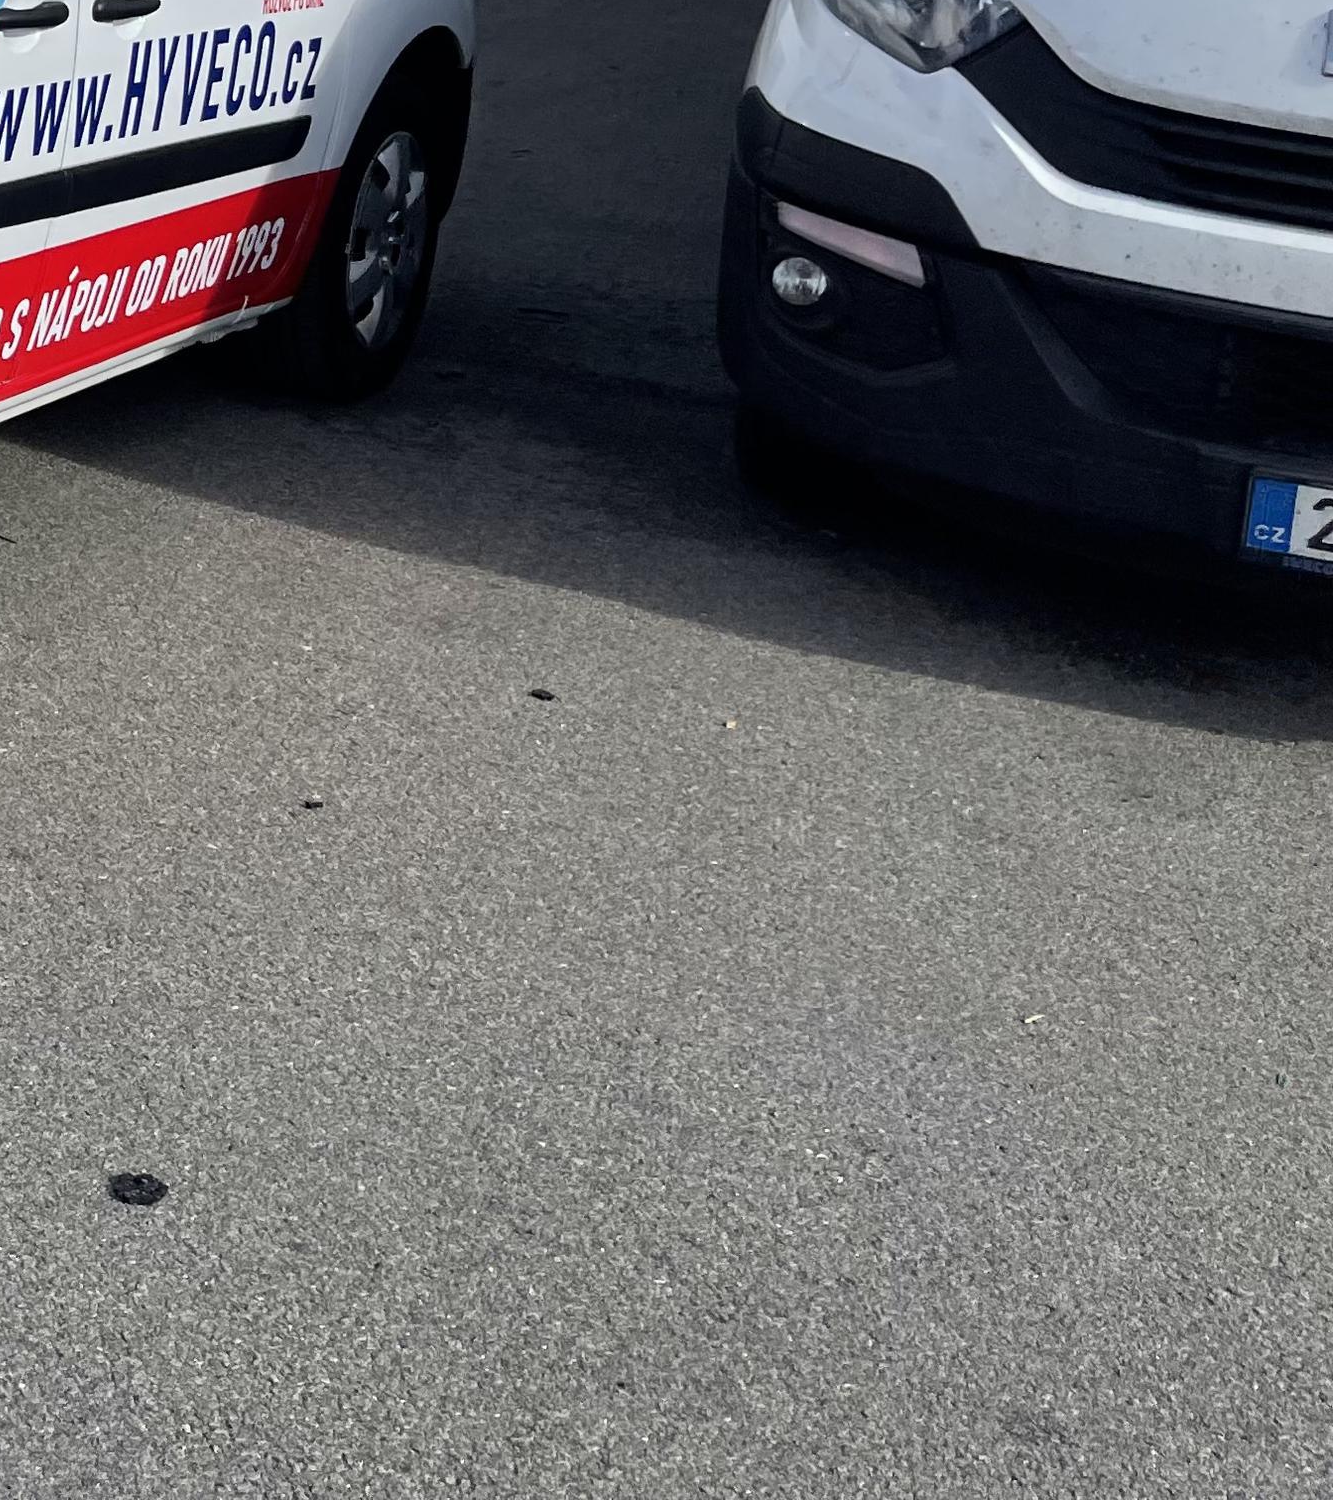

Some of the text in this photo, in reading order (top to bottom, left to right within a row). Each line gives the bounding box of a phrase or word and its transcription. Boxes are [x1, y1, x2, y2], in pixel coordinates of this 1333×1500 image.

[1, 306, 27, 361] S
[26, 265, 133, 354] NÁPOJI
[127, 256, 169, 314] OD
[168, 233, 231, 306] ROKU
[226, 217, 286, 281] 1993
[1253, 524, 1286, 544] CZ
